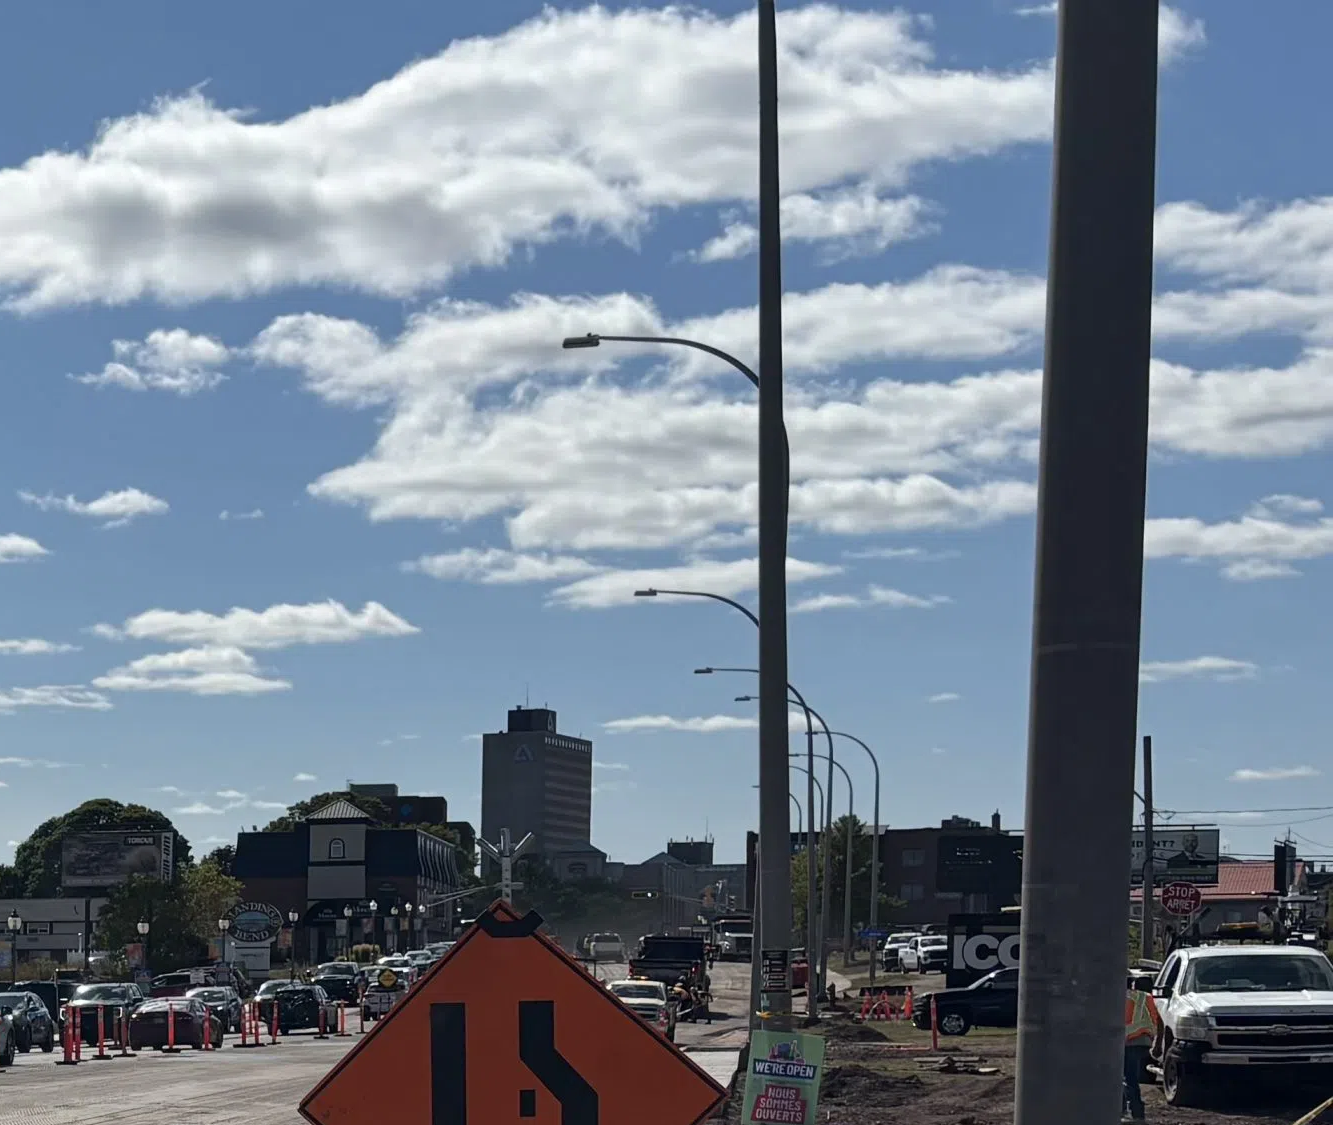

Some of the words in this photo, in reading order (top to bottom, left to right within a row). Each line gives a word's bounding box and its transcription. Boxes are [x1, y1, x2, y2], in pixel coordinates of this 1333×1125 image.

[1167, 886, 1196, 898] STOP
[234, 930, 269, 941] BEND
[755, 1061, 786, 1076] WE'RE
[786, 1065, 814, 1078] OPEN
[768, 1086, 796, 1099] NOUS
[759, 1097, 801, 1111] SOMMES
[755, 1107, 803, 1122] OUVERTS
